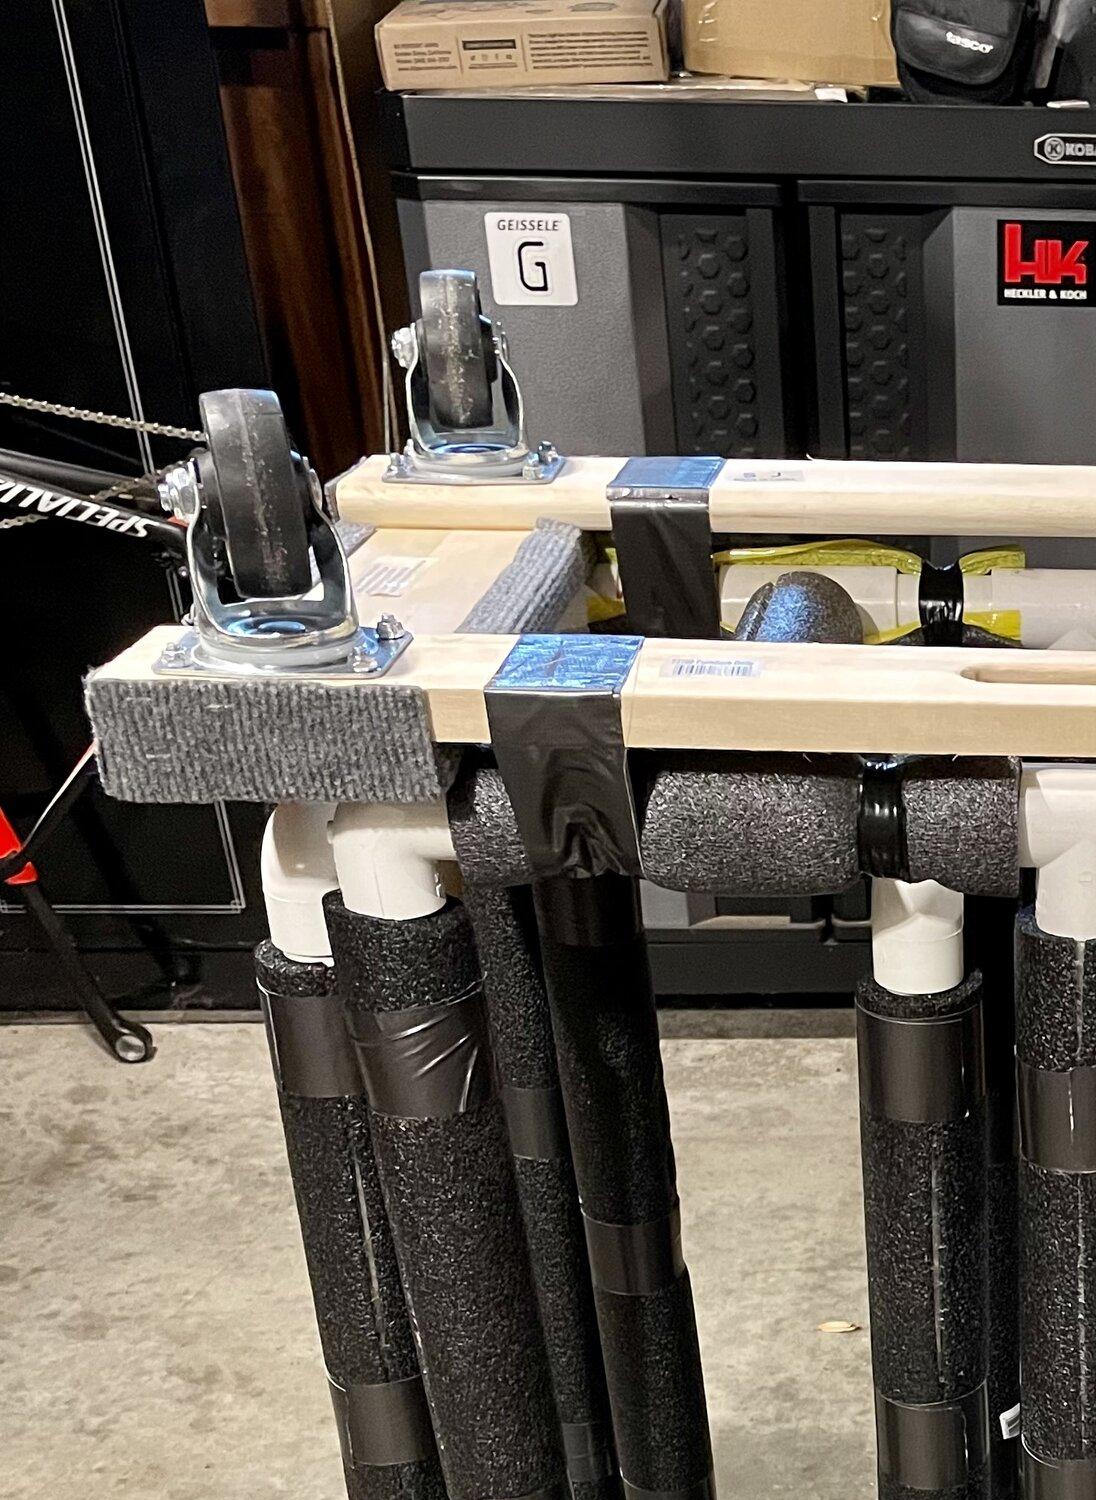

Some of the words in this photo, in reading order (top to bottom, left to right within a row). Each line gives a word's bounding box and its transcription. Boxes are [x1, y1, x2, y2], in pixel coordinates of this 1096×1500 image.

[497, 219, 560, 232] GEISSELE
[517, 241, 549, 292] G
[1003, 288, 1047, 299] HECKLER
[1048, 289, 1058, 300] &
[1059, 290, 1088, 300] KOCH
